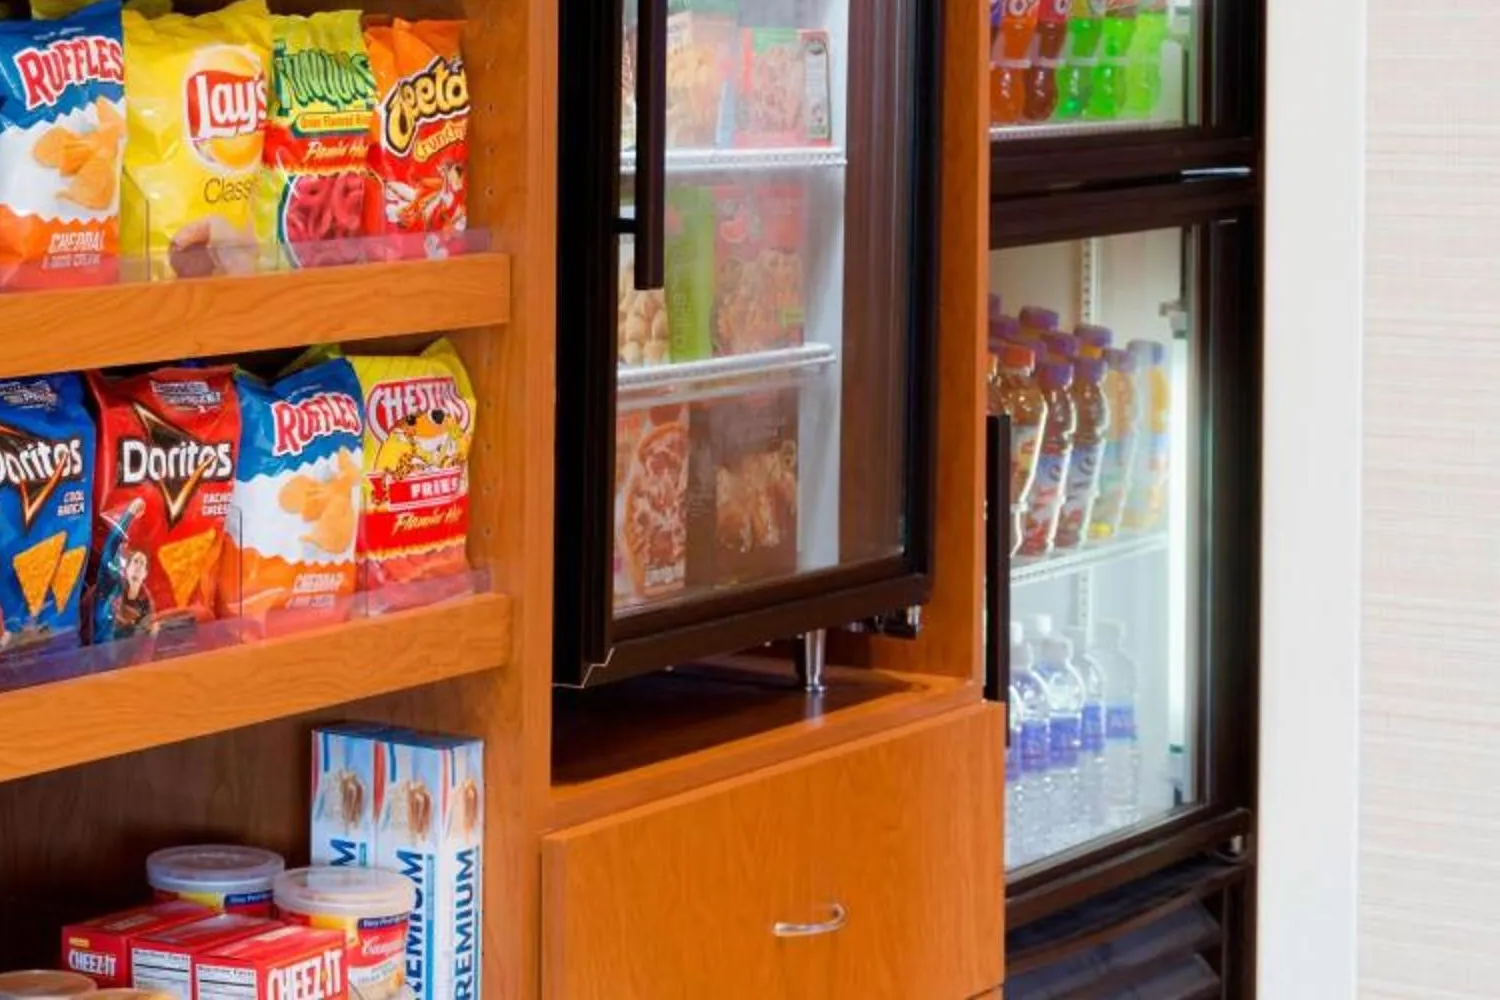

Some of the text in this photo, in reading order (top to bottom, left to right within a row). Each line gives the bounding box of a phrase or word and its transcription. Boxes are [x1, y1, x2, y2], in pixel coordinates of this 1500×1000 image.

[16, 36, 123, 110] RUFFLES
[122, 439, 234, 483] Doritos
[455, 849, 474, 1000] REMIUM
